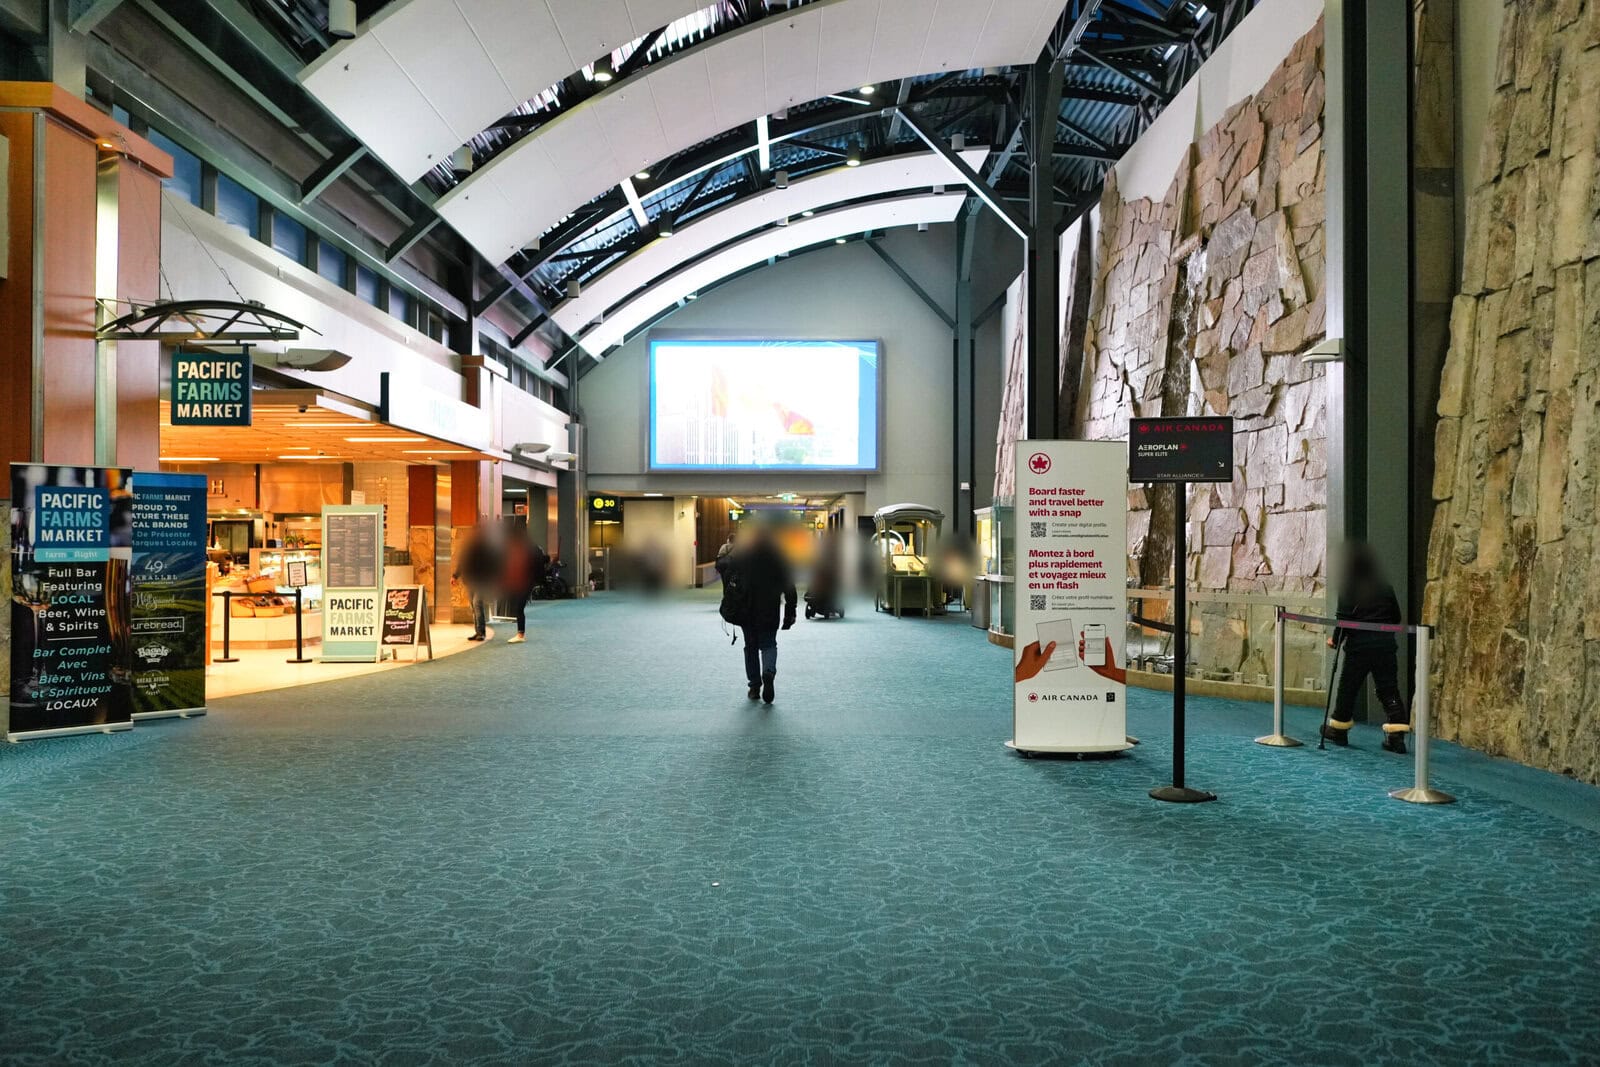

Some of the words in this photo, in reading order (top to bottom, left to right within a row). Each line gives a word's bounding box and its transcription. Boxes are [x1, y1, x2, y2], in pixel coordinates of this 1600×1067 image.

[177, 361, 242, 379] PACIFIC
[177, 382, 241, 401] FARMS
[177, 403, 243, 418] MARKET
[1154, 424, 1173, 432] AIR
[1176, 424, 1225, 432] CANADA
[1029, 487, 1057, 495] Board
[1059, 487, 1085, 496] faster
[41, 493, 103, 509] PACIFIC
[604, 499, 615, 507] 30
[1029, 498, 1046, 506] and
[1048, 498, 1075, 506] travel
[1077, 498, 1104, 506] better
[1029, 508, 1050, 516] with
[1059, 510, 1081, 518] snap
[41, 511, 102, 527] FARMS
[152, 521, 188, 529] BRANDS
[41, 529, 103, 542] MARKET
[45, 551, 66, 559] farm
[1066, 549, 1072, 557] à
[1073, 549, 1094, 557] bord
[1028, 560, 1049, 569] plus
[1050, 560, 1102, 570] rapidement
[48, 568, 71, 578] Full
[76, 568, 97, 577] Bar
[1028, 571, 1038, 579] et
[1040, 572, 1078, 580] voyagez
[1079, 571, 1107, 579] mieux
[42, 581, 102, 591] Featuring
[1056, 581, 1079, 589] flash
[51, 595, 95, 605] LOCAL
[330, 598, 374, 610] PACIFIC
[38, 609, 70, 619] Beer,
[74, 607, 106, 617] Wine
[330, 612, 373, 625] FARMS
[46, 622, 54, 632] &
[59, 621, 99, 632] Spirits
[131, 621, 182, 630] urebread.
[330, 626, 375, 636] MARKET
[32, 648, 55, 658] Bar
[59, 644, 111, 656] Complet
[57, 660, 88, 670] Avec
[38, 673, 75, 685] Bière,
[80, 671, 105, 681] Vins
[31, 690, 44, 699] et
[48, 685, 112, 698] Spiritueux
[45, 697, 99, 711] LOCAUX
